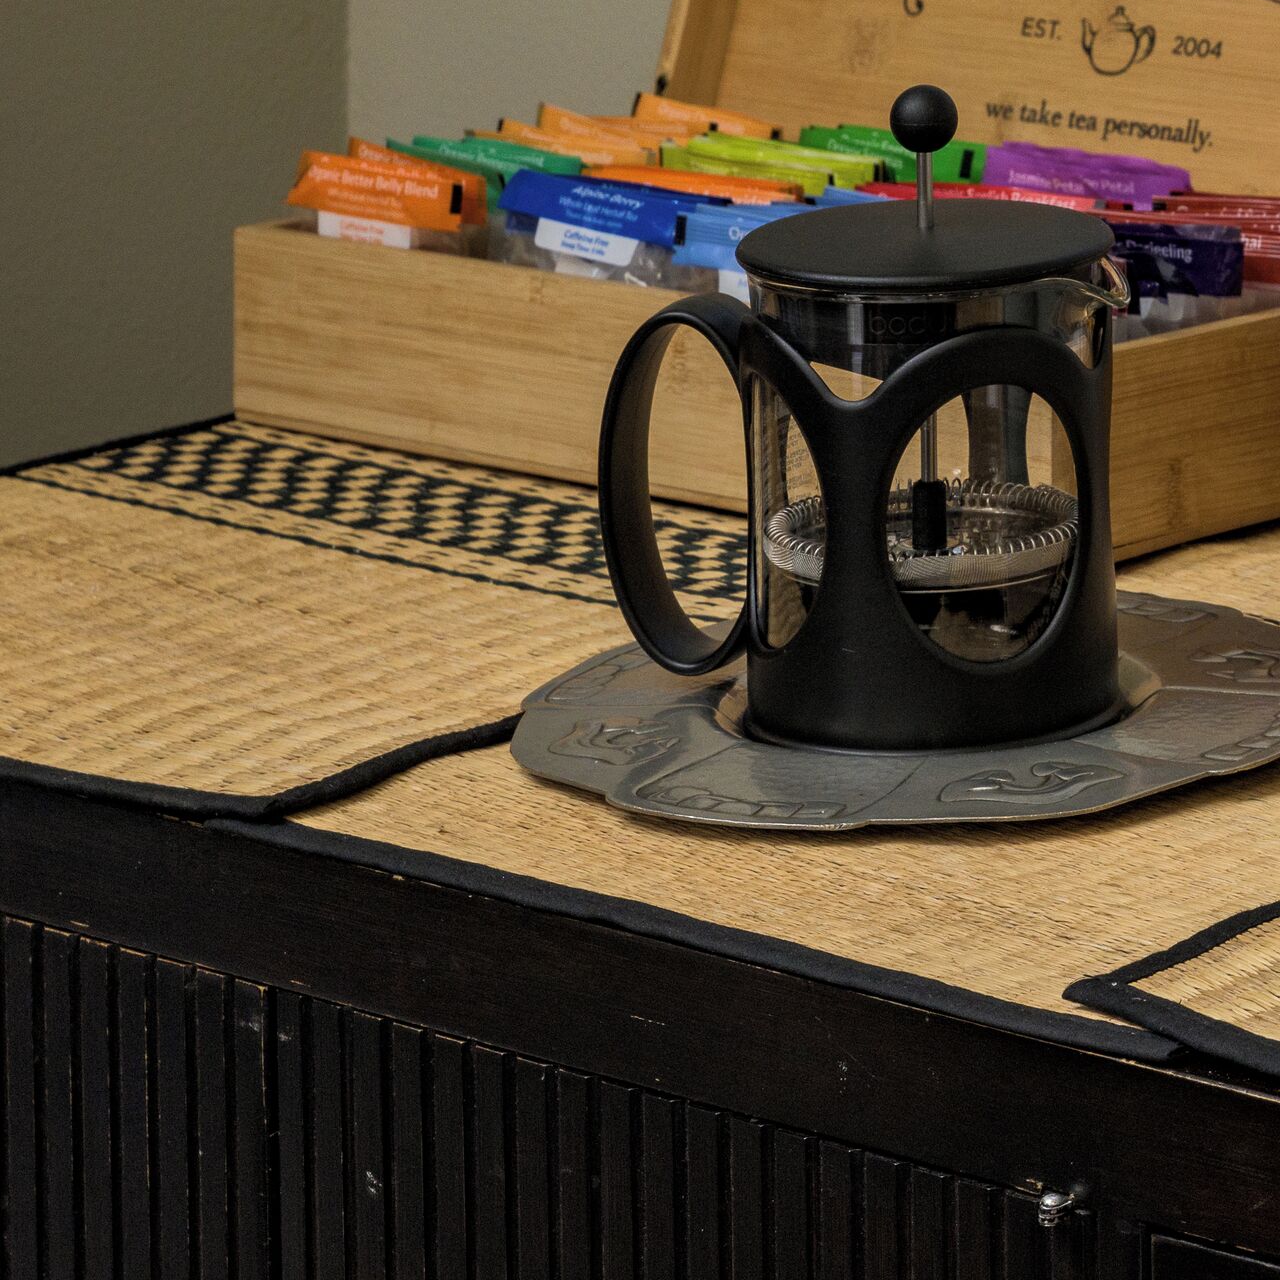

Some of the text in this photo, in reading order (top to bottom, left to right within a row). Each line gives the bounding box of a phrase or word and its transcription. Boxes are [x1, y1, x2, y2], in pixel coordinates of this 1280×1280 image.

[1021, 16, 1223, 58] EST. 2004
[986, 98, 1213, 153] we take tea personally.
[1240, 232, 1263, 249] hai
